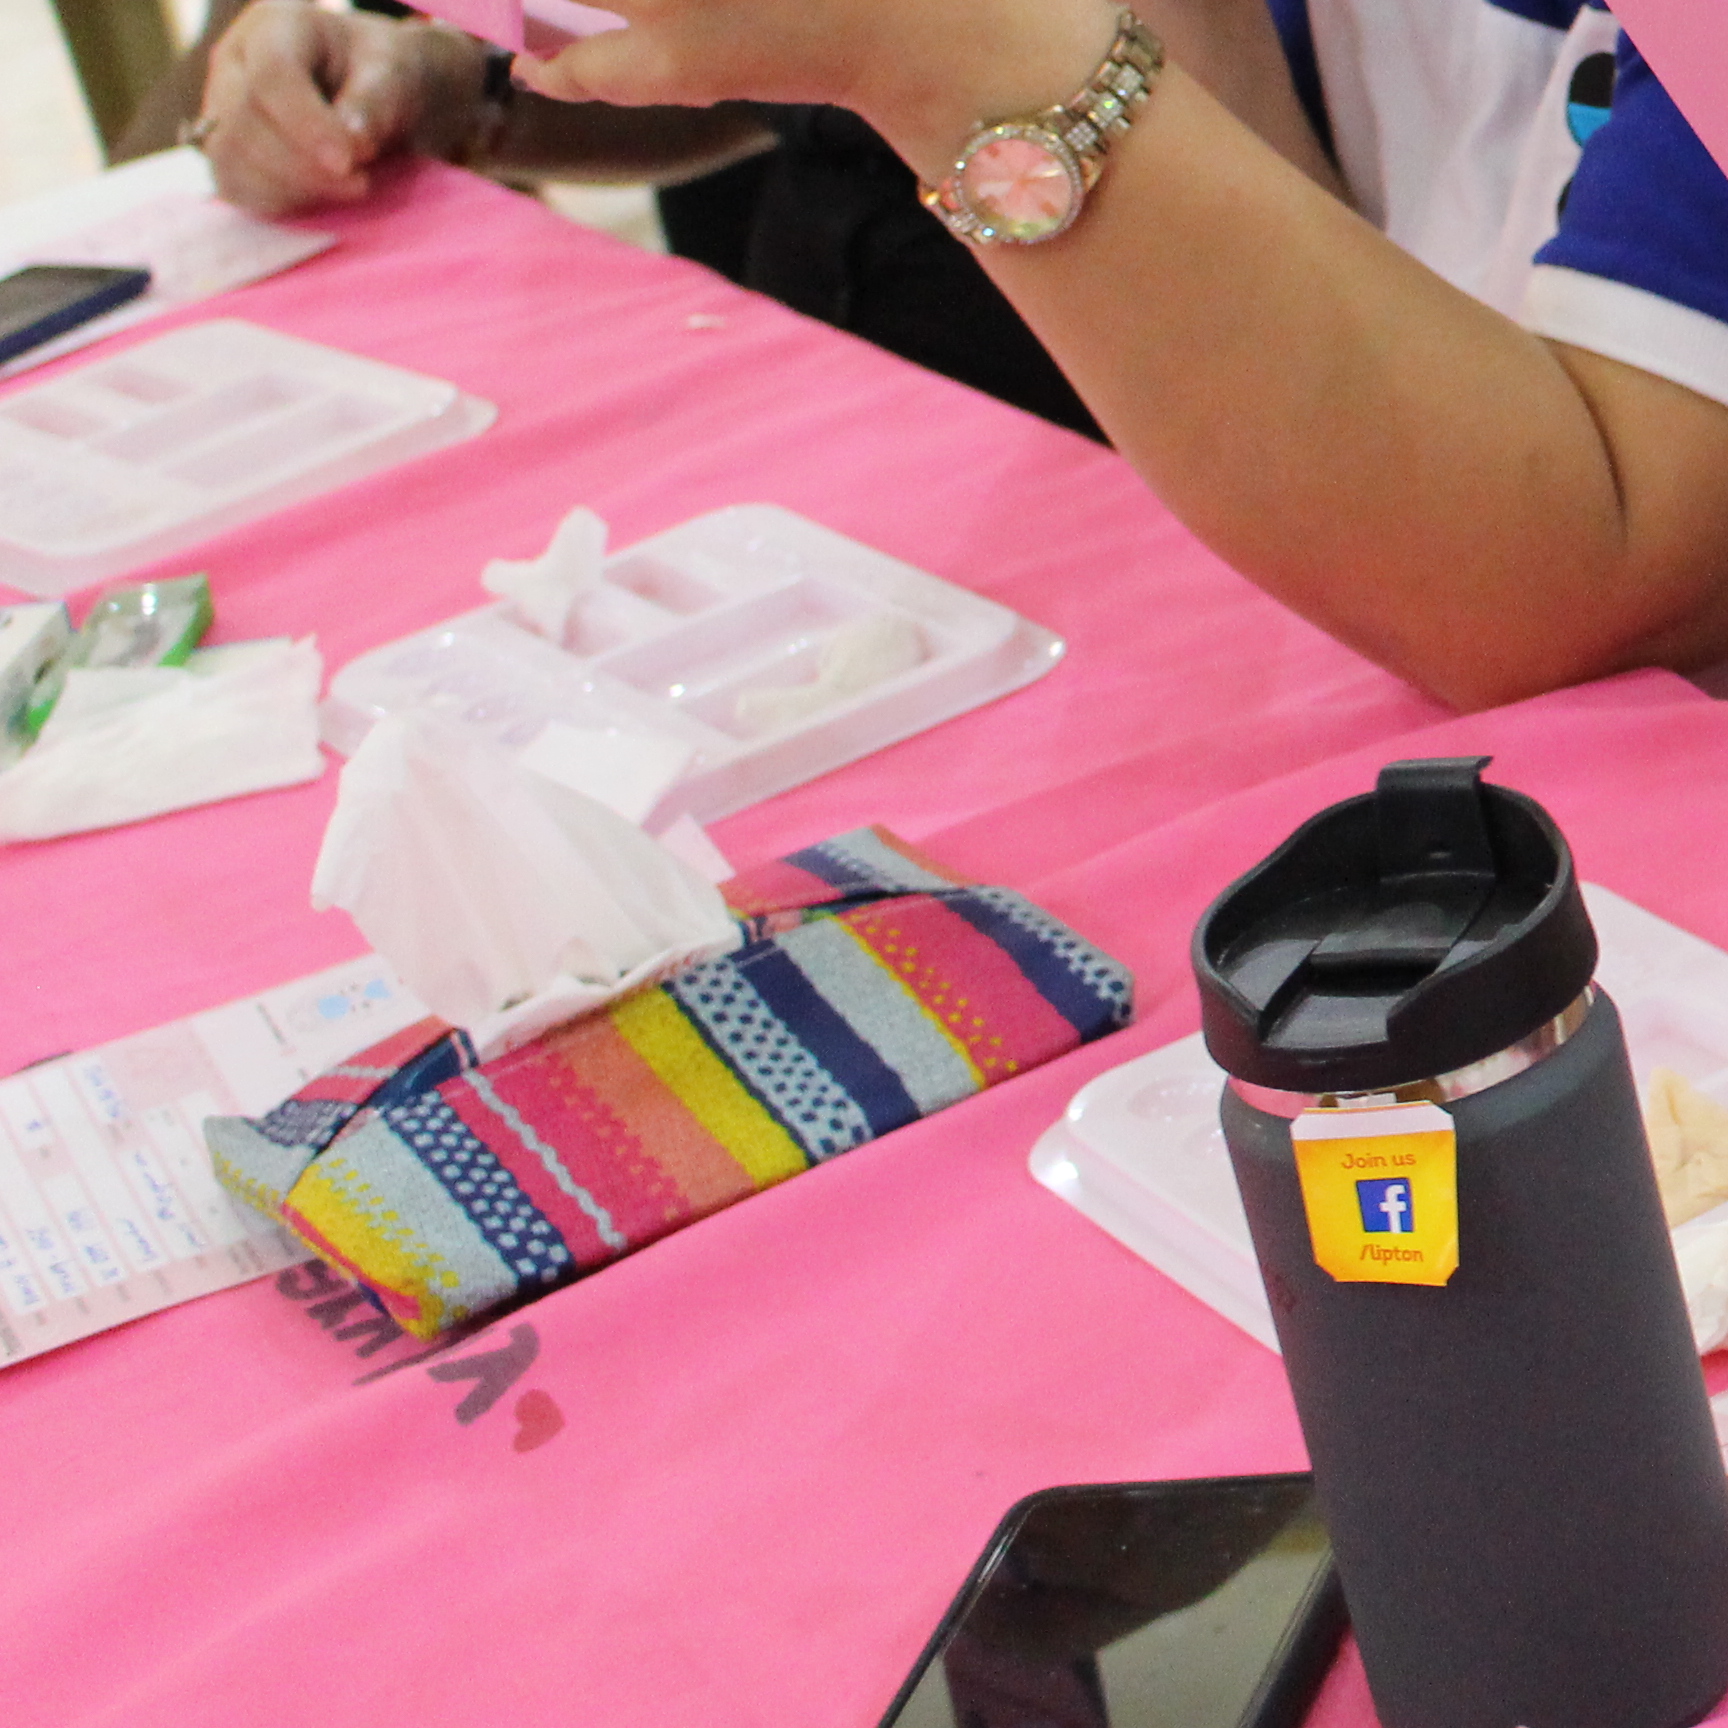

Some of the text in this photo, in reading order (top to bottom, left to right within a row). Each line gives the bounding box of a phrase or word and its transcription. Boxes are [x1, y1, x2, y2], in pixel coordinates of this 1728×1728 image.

[1341, 1153, 1416, 1169] Join us
[1379, 1184, 1407, 1233] f
